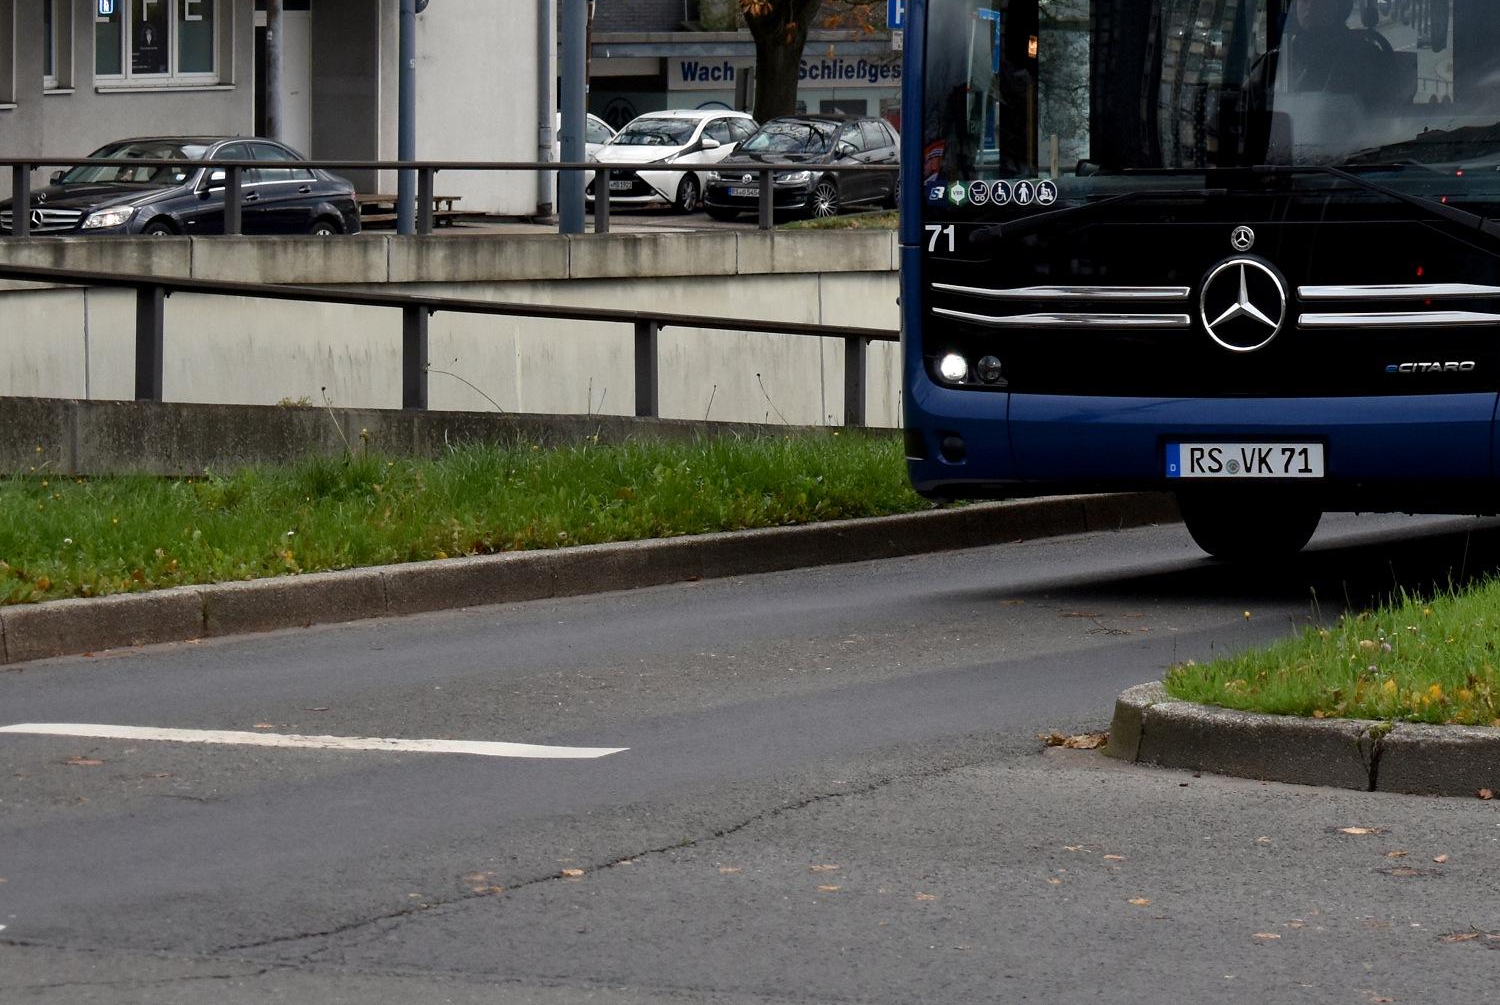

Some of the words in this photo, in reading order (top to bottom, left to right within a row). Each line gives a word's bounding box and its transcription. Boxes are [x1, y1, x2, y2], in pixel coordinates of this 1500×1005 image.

[680, 61, 735, 82] Wach
[924, 224, 955, 252] 71
[1384, 360, 1476, 373] eCITARO
[1189, 447, 1223, 474] RS
[1240, 447, 1274, 474] VK
[1281, 447, 1313, 474] 71
